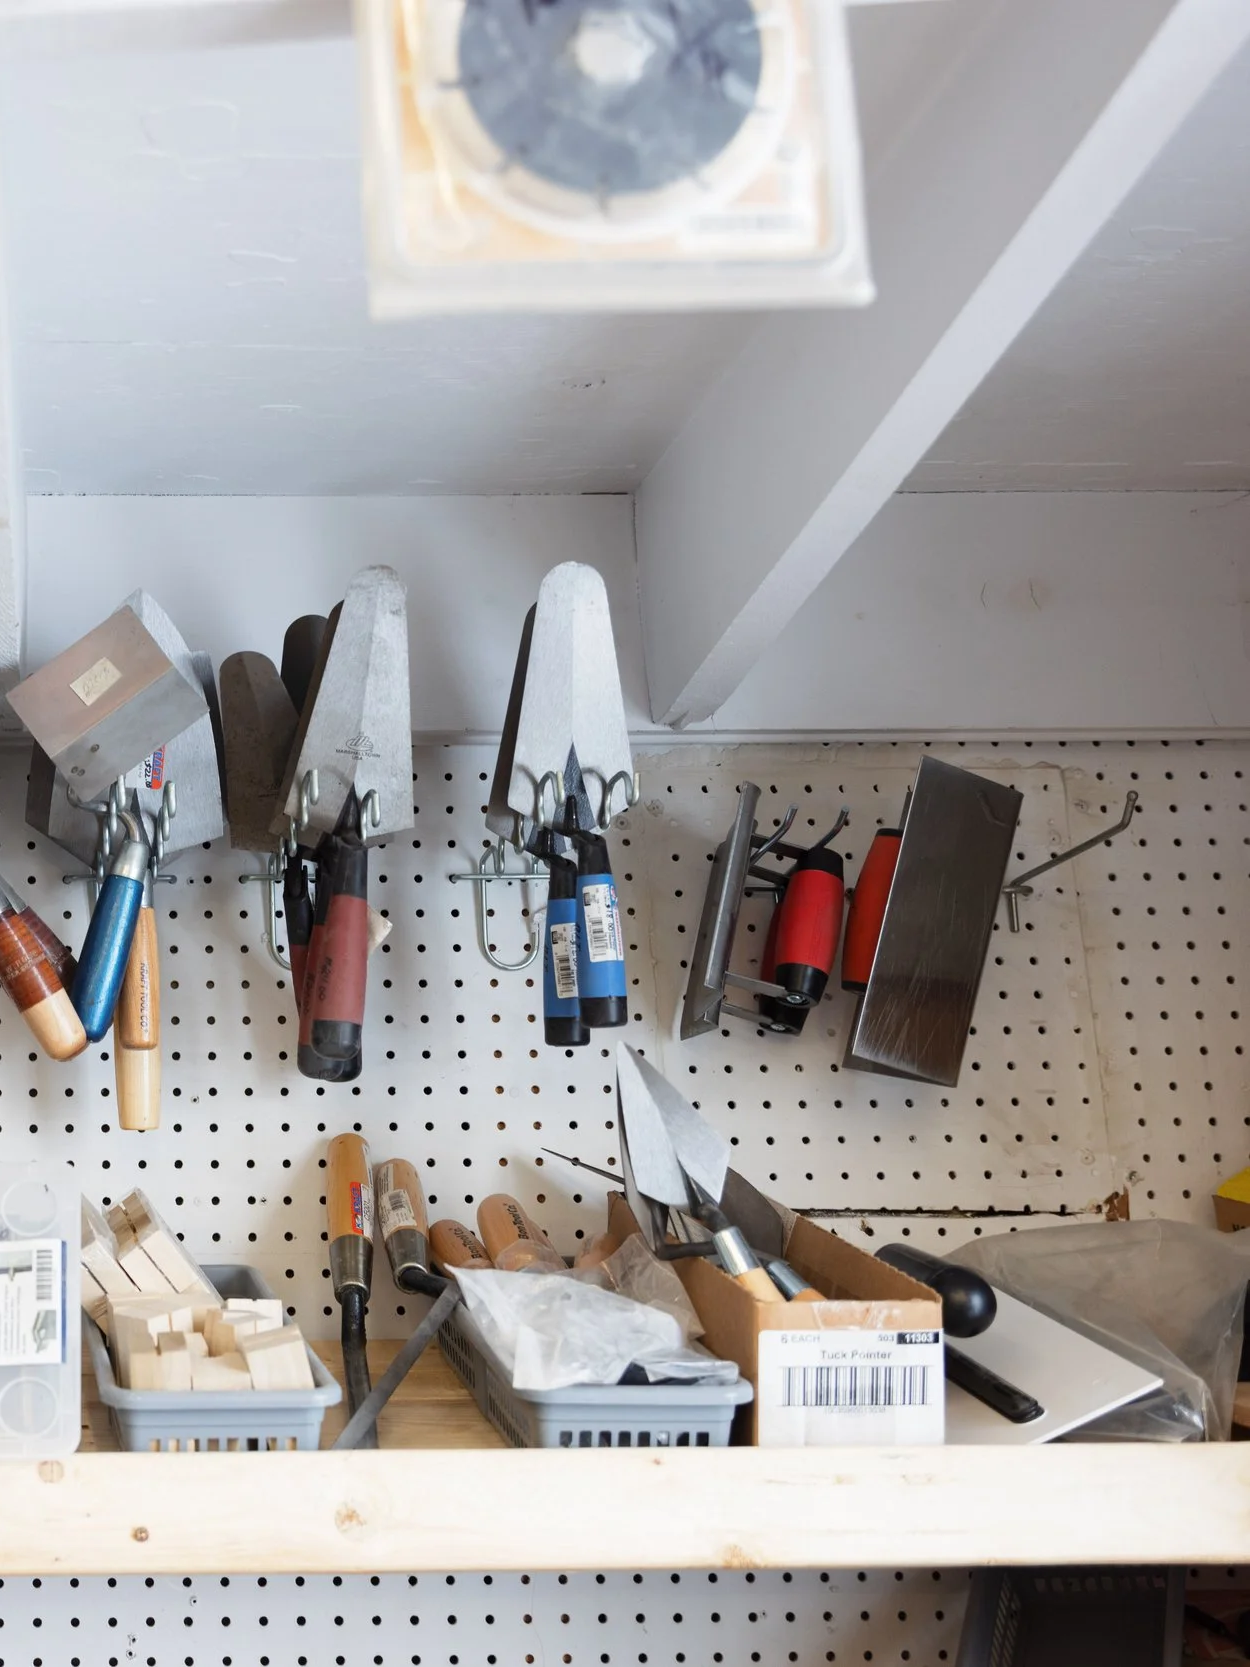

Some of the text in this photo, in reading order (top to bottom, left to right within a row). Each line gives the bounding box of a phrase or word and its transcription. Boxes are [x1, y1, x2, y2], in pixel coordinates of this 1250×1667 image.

[150, 751, 165, 781] RAFT
[140, 991, 148, 1012] TOOL
[791, 1334, 820, 1343] EACH
[904, 1333, 934, 1343] 11303
[821, 1350, 892, 1360] Tuck Pointer
